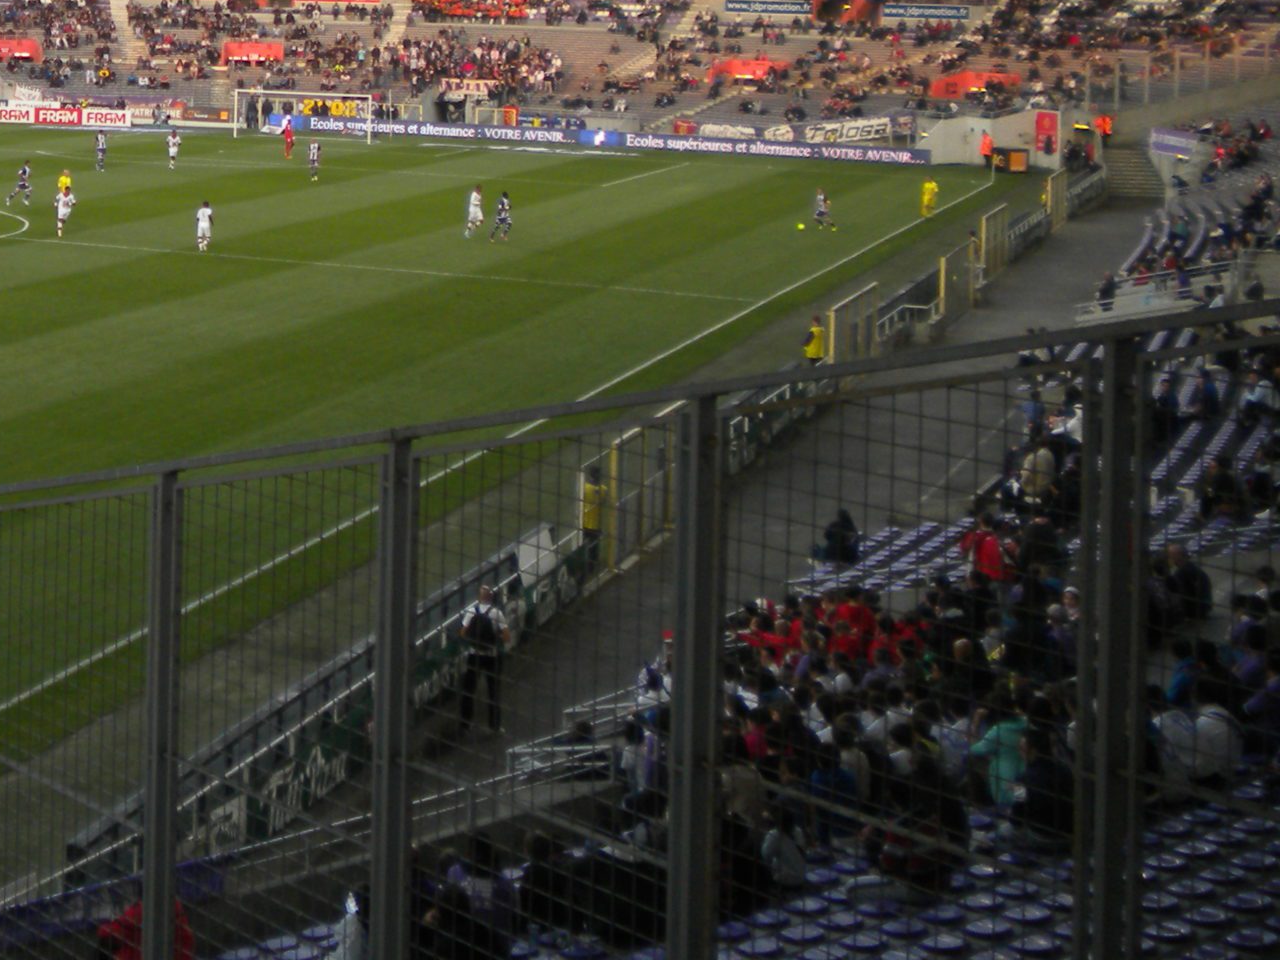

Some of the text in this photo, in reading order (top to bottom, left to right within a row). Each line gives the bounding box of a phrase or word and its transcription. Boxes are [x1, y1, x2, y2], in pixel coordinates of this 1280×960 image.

[727, 0, 810, 12] www.jdpromotion.fr
[884, 5, 967, 17] www.jdpromotion.fr
[38, 110, 78, 122] FRAM
[86, 111, 126, 124] FRAM
[310, 117, 345, 130] Ecoles
[407, 123, 419, 134] et
[420, 122, 476, 138] alternance
[484, 127, 521, 140] VOTRE
[809, 122, 890, 141] Tolosa
[625, 134, 665, 148] Ecoles
[666, 136, 734, 154] supérieures
[735, 141, 747, 153] et
[749, 140, 812, 158] alternance
[822, 146, 864, 160] VOTRE
